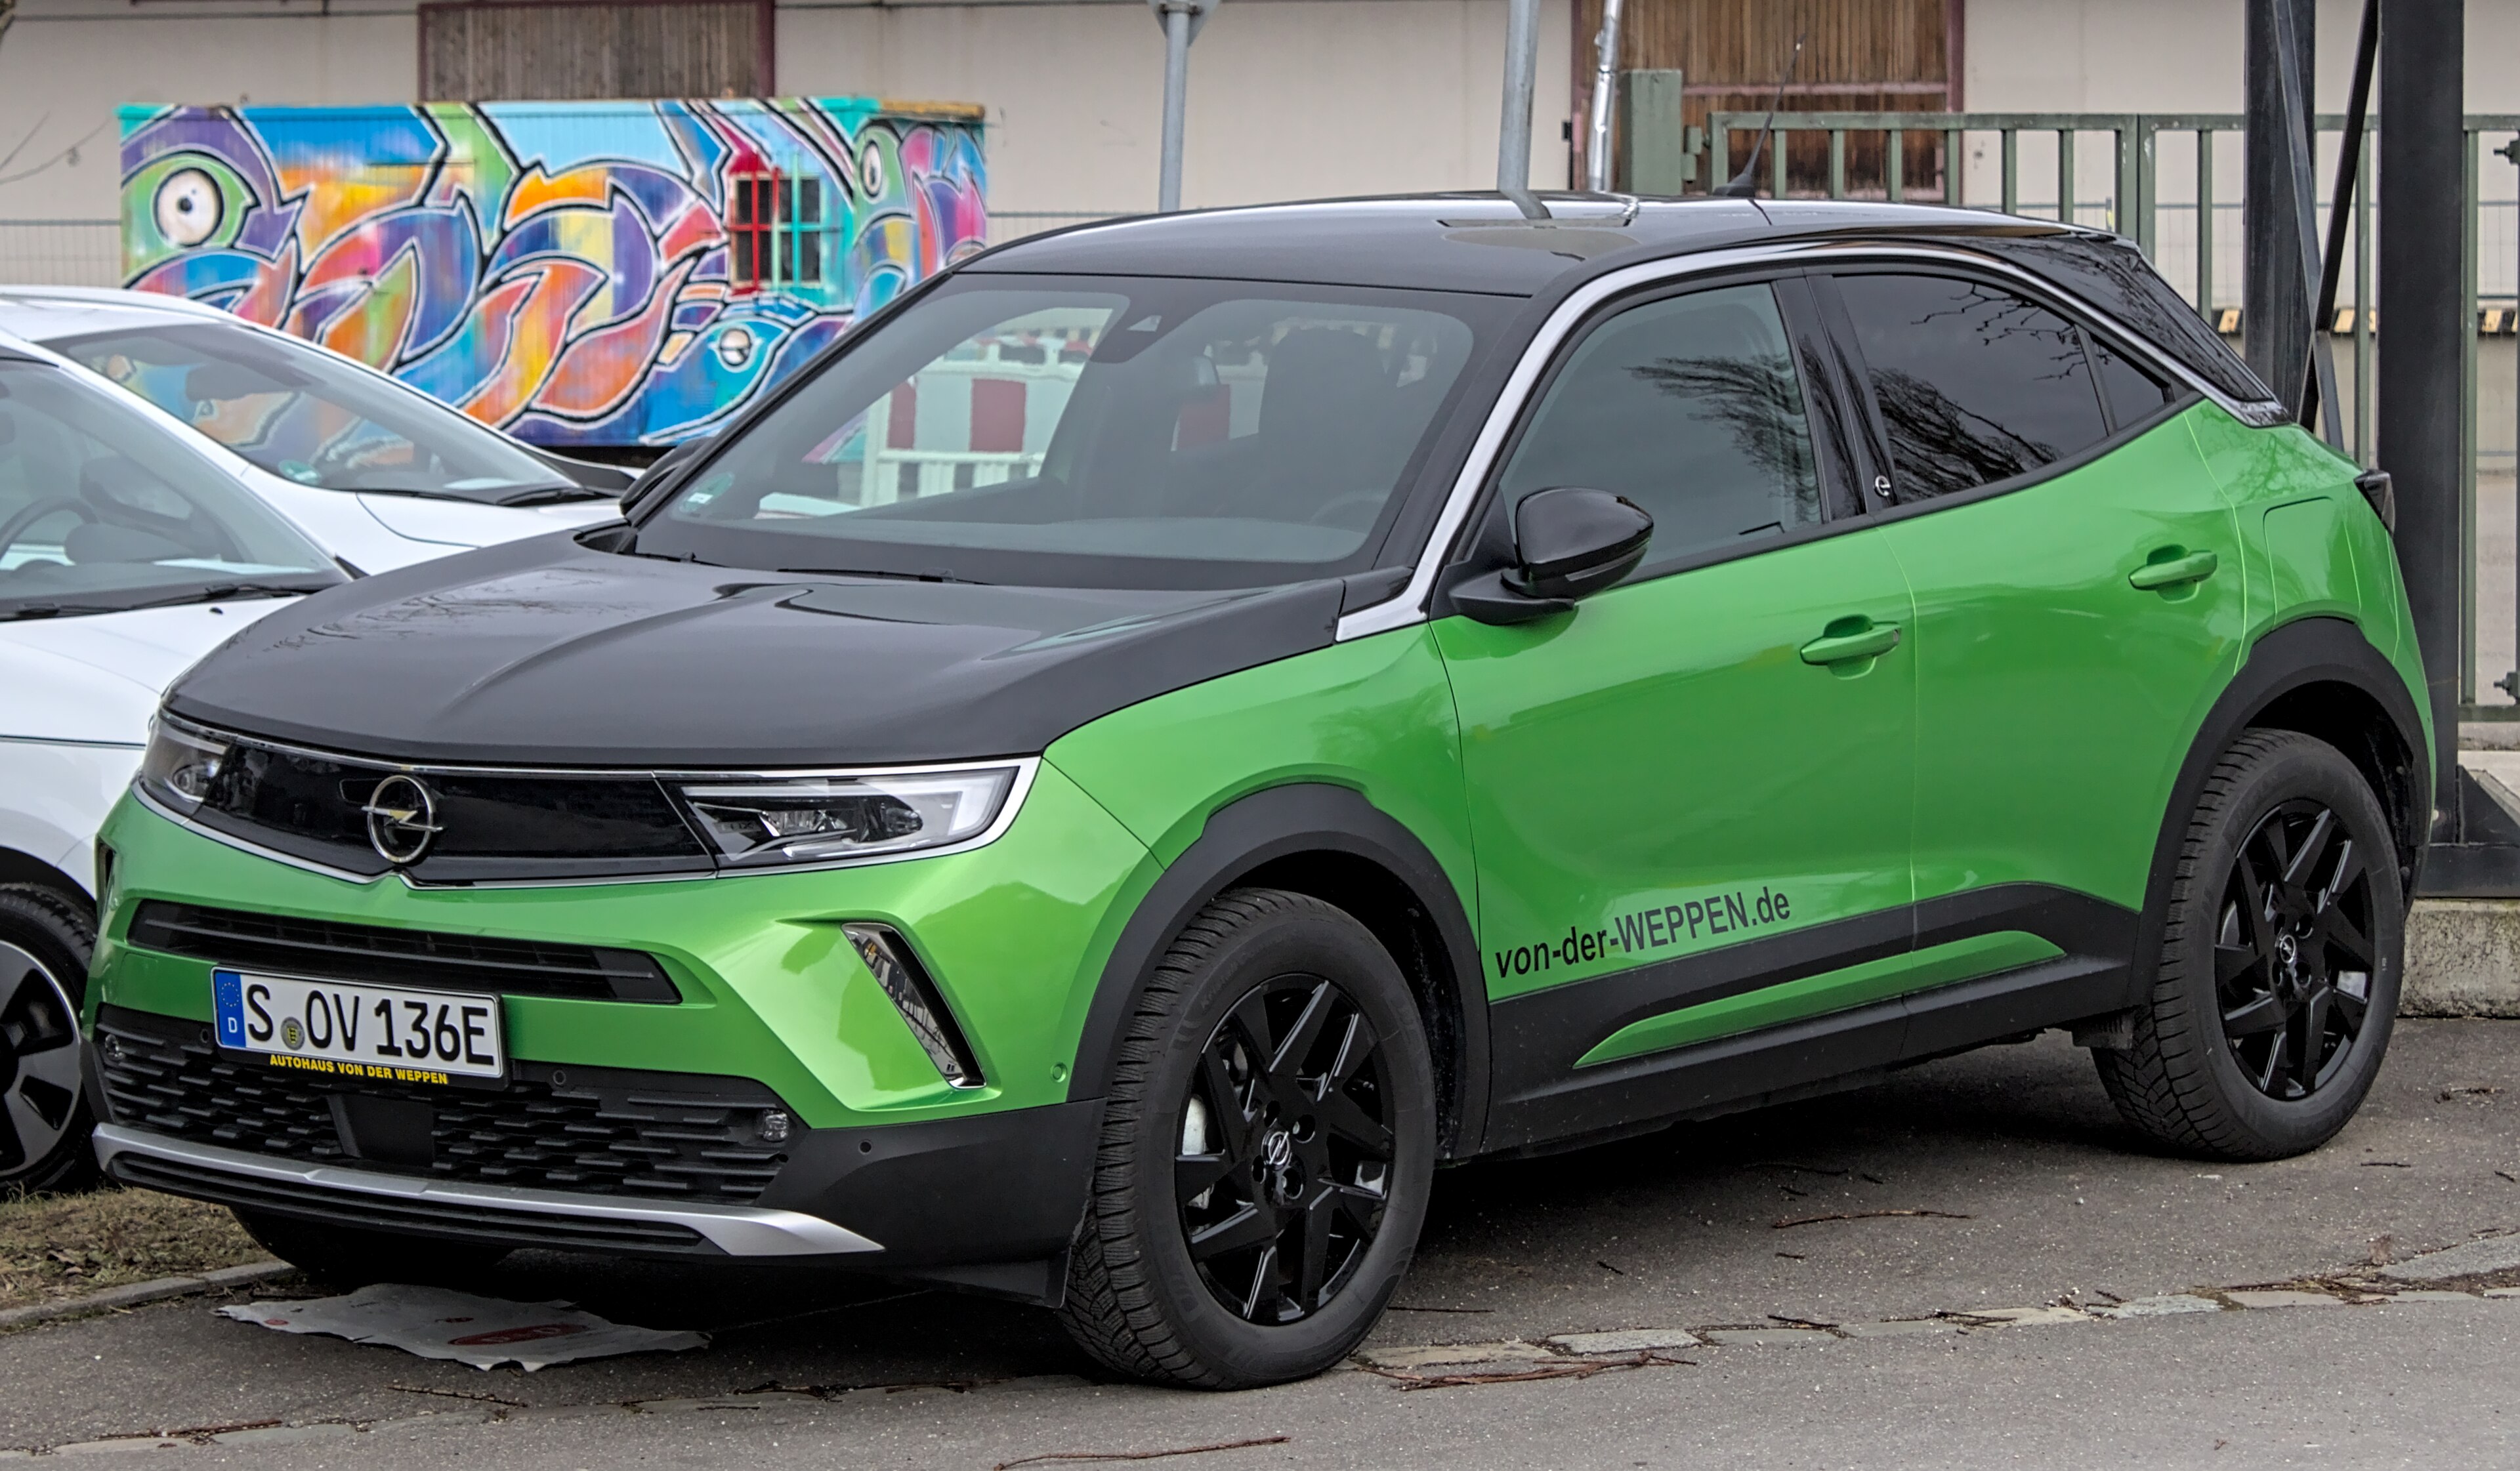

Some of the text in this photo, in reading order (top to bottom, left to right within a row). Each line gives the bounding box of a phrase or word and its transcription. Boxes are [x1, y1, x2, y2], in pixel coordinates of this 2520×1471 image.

[1496, 886, 1790, 978] von-der-WEPPEN.de
[228, 1017, 238, 1033] D
[247, 984, 494, 1066] S OV 136E
[270, 1054, 448, 1085] AUTOHAUS VON DER WEPPEN
